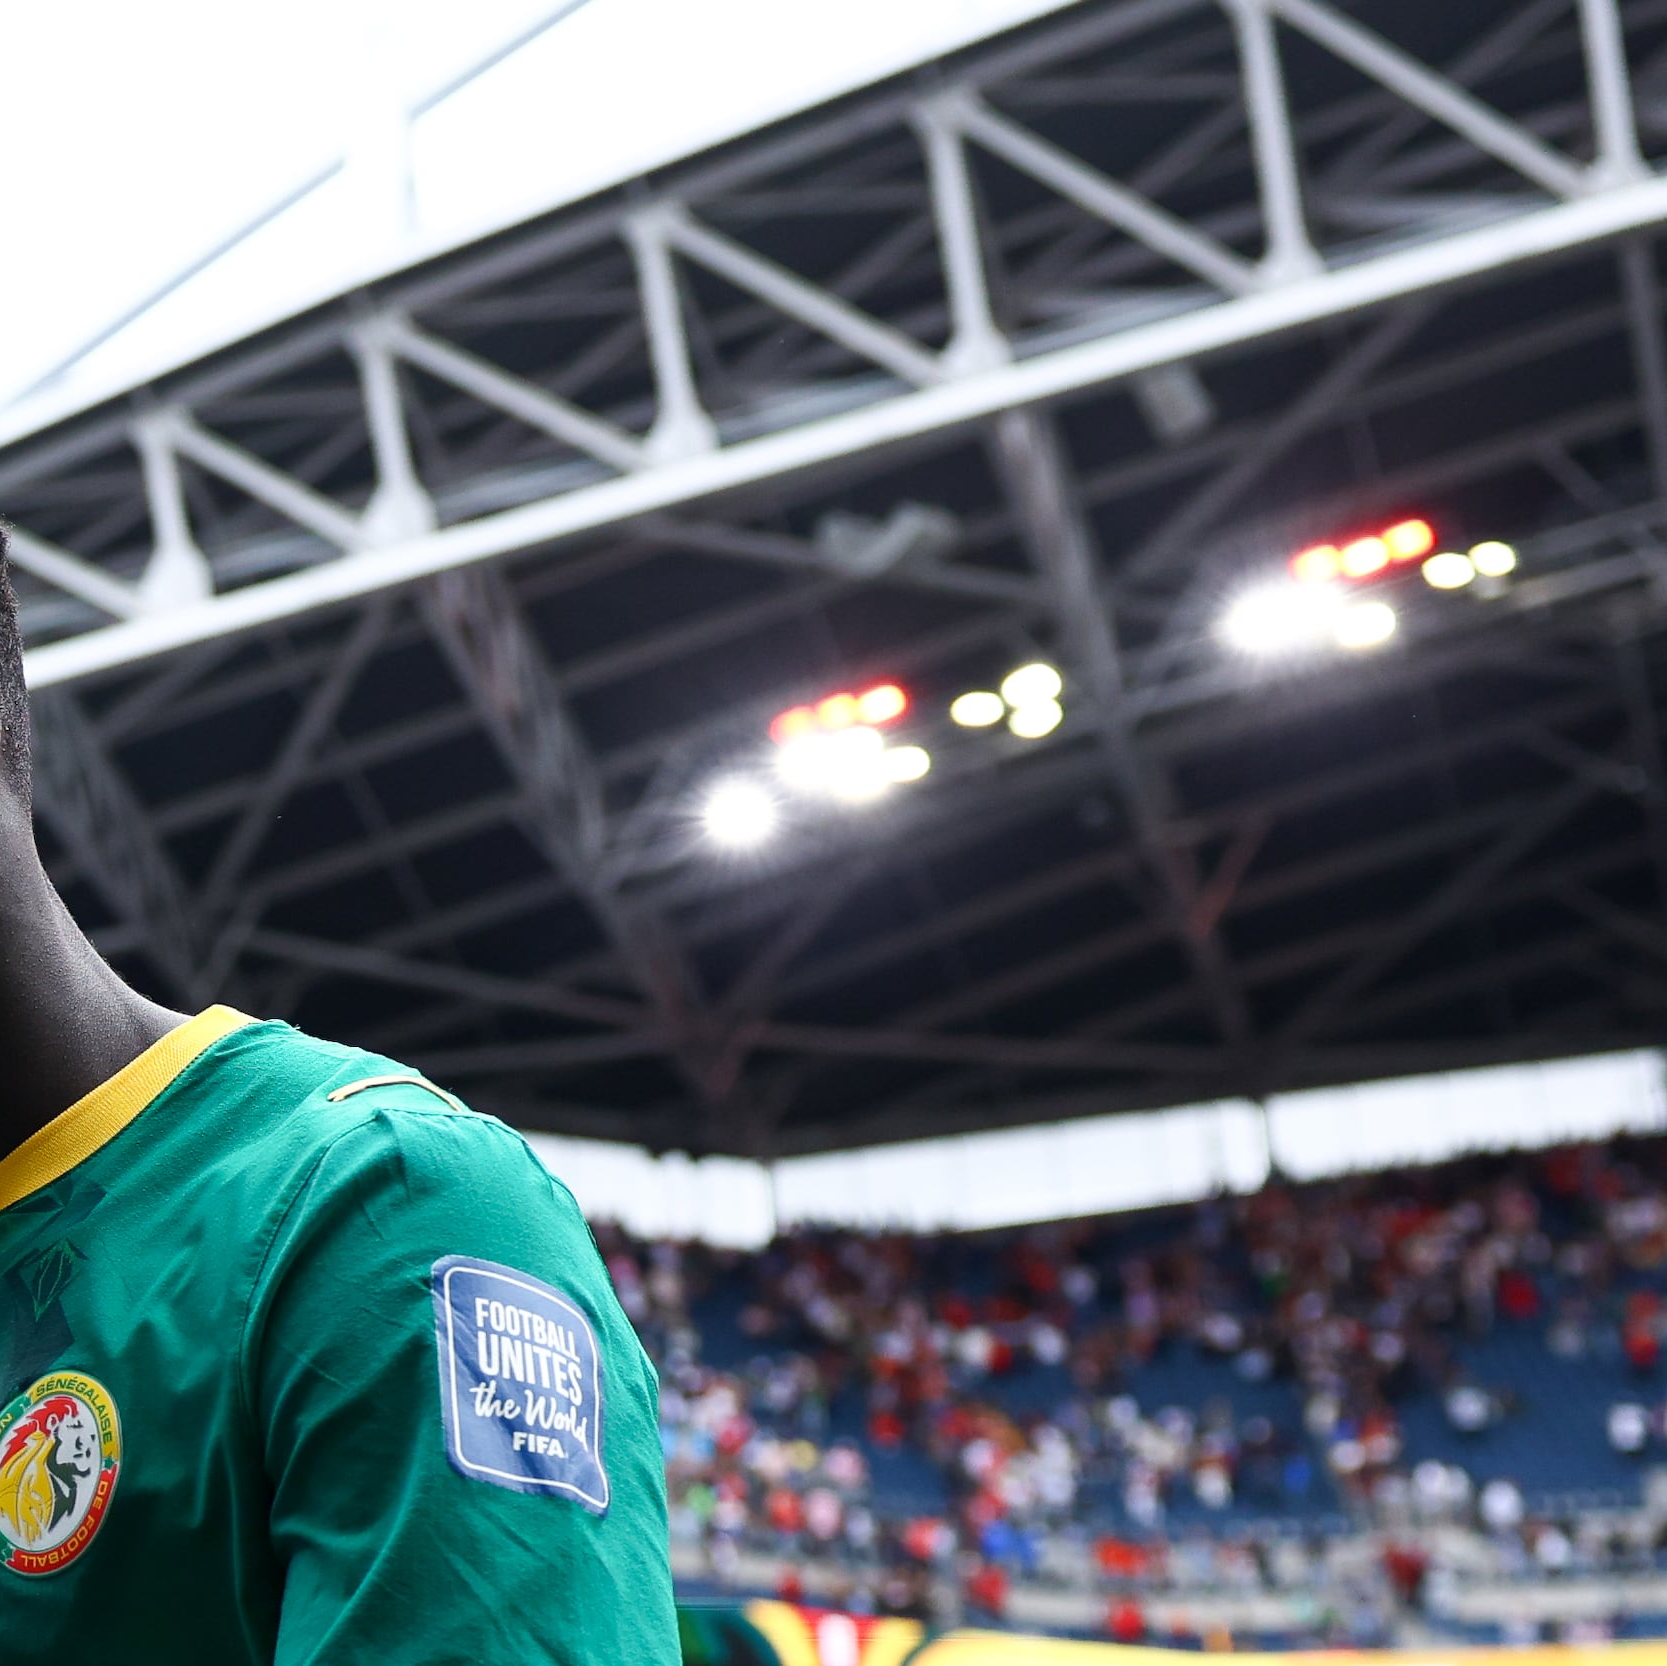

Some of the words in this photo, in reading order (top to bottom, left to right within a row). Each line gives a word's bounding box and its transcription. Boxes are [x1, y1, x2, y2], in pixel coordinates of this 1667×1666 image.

[474, 1297, 581, 1363] FOOTBALL
[477, 1331, 583, 1406] UNITES
[35, 1376, 113, 1445] SÉNÉGALAISE
[469, 1380, 521, 1418] the
[524, 1389, 589, 1452] World
[512, 1431, 569, 1459] FIFA
[21, 1514, 96, 1568] FOOTBALL
